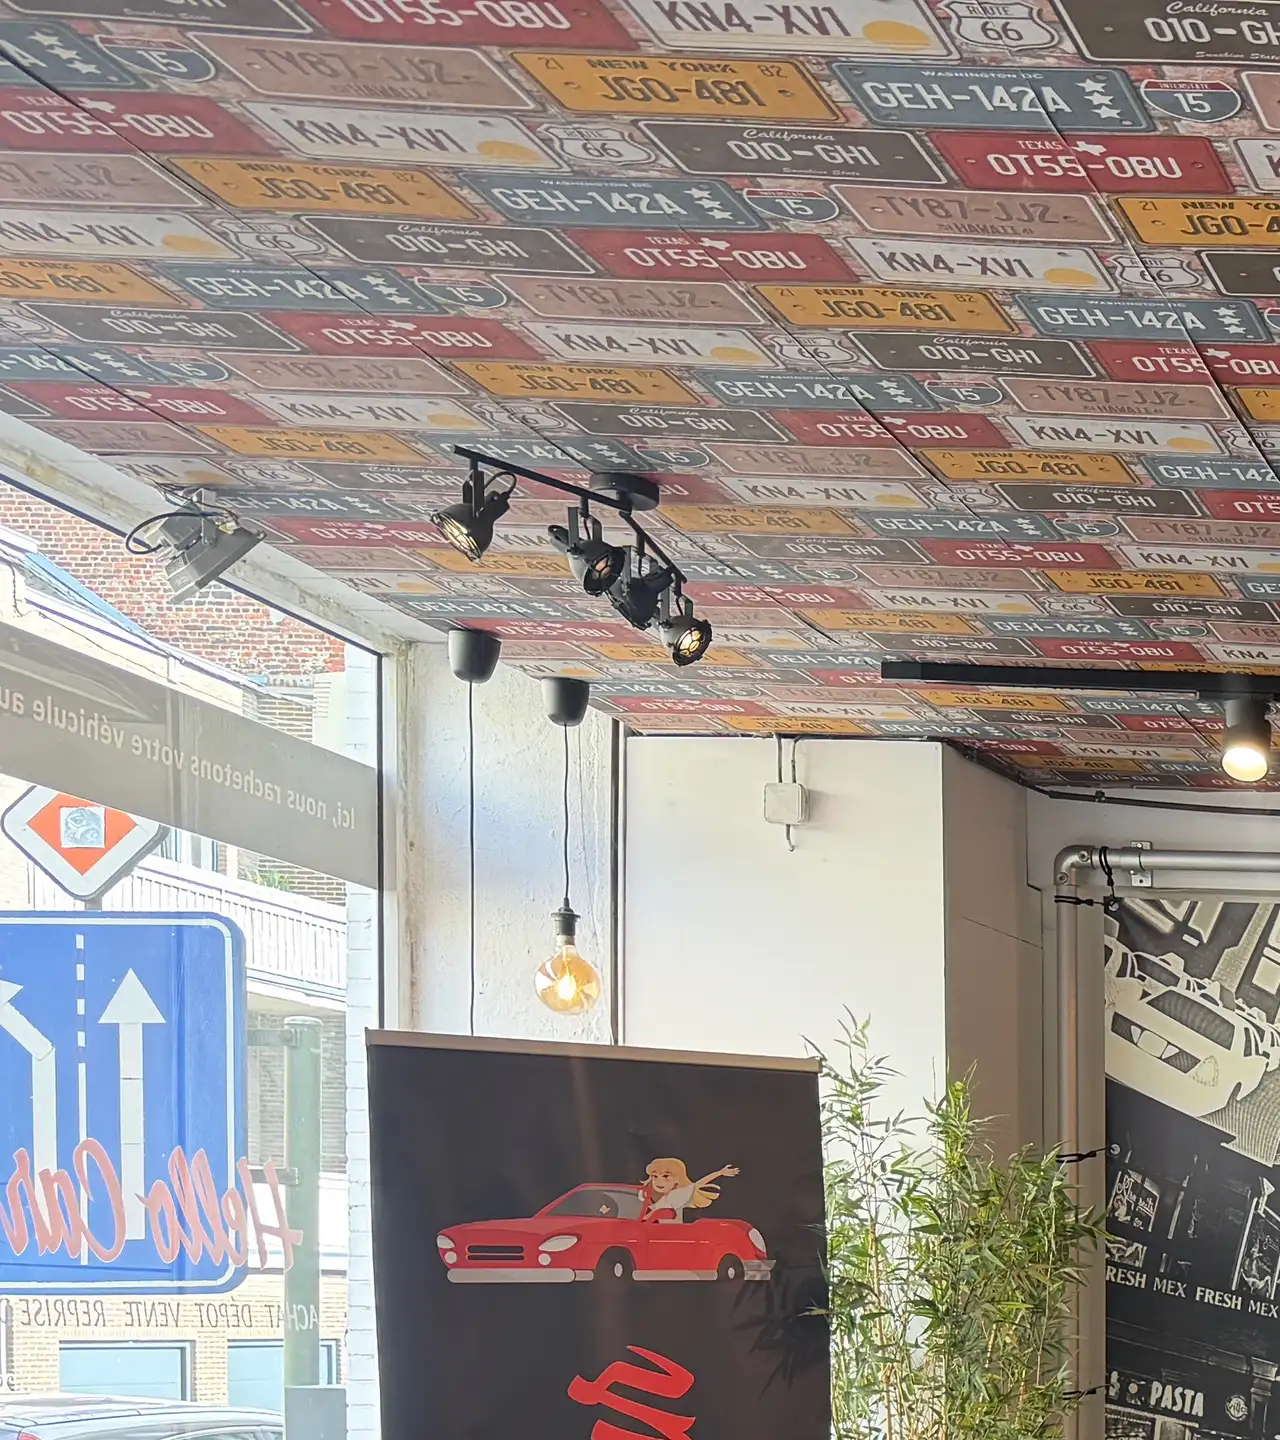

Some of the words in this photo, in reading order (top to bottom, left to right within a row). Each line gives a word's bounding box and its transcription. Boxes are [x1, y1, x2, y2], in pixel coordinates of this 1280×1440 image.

[964, 5, 1014, 17] ROUTE
[1163, 0, 1270, 17] California
[976, 21, 1028, 42] 66
[861, 83, 1073, 113] GEH-142A
[1174, 92, 1214, 114] 15
[490, 189, 689, 215] GEH-142A
[184, 277, 371, 300] GEH-142A
[1106, 1264, 1147, 1290] RESH
[1153, 1276, 1188, 1298] MEX
[1195, 1286, 1243, 1311] FRESH
[1248, 1300, 1280, 1319] MEX
[1150, 1380, 1204, 1418] PASTA
